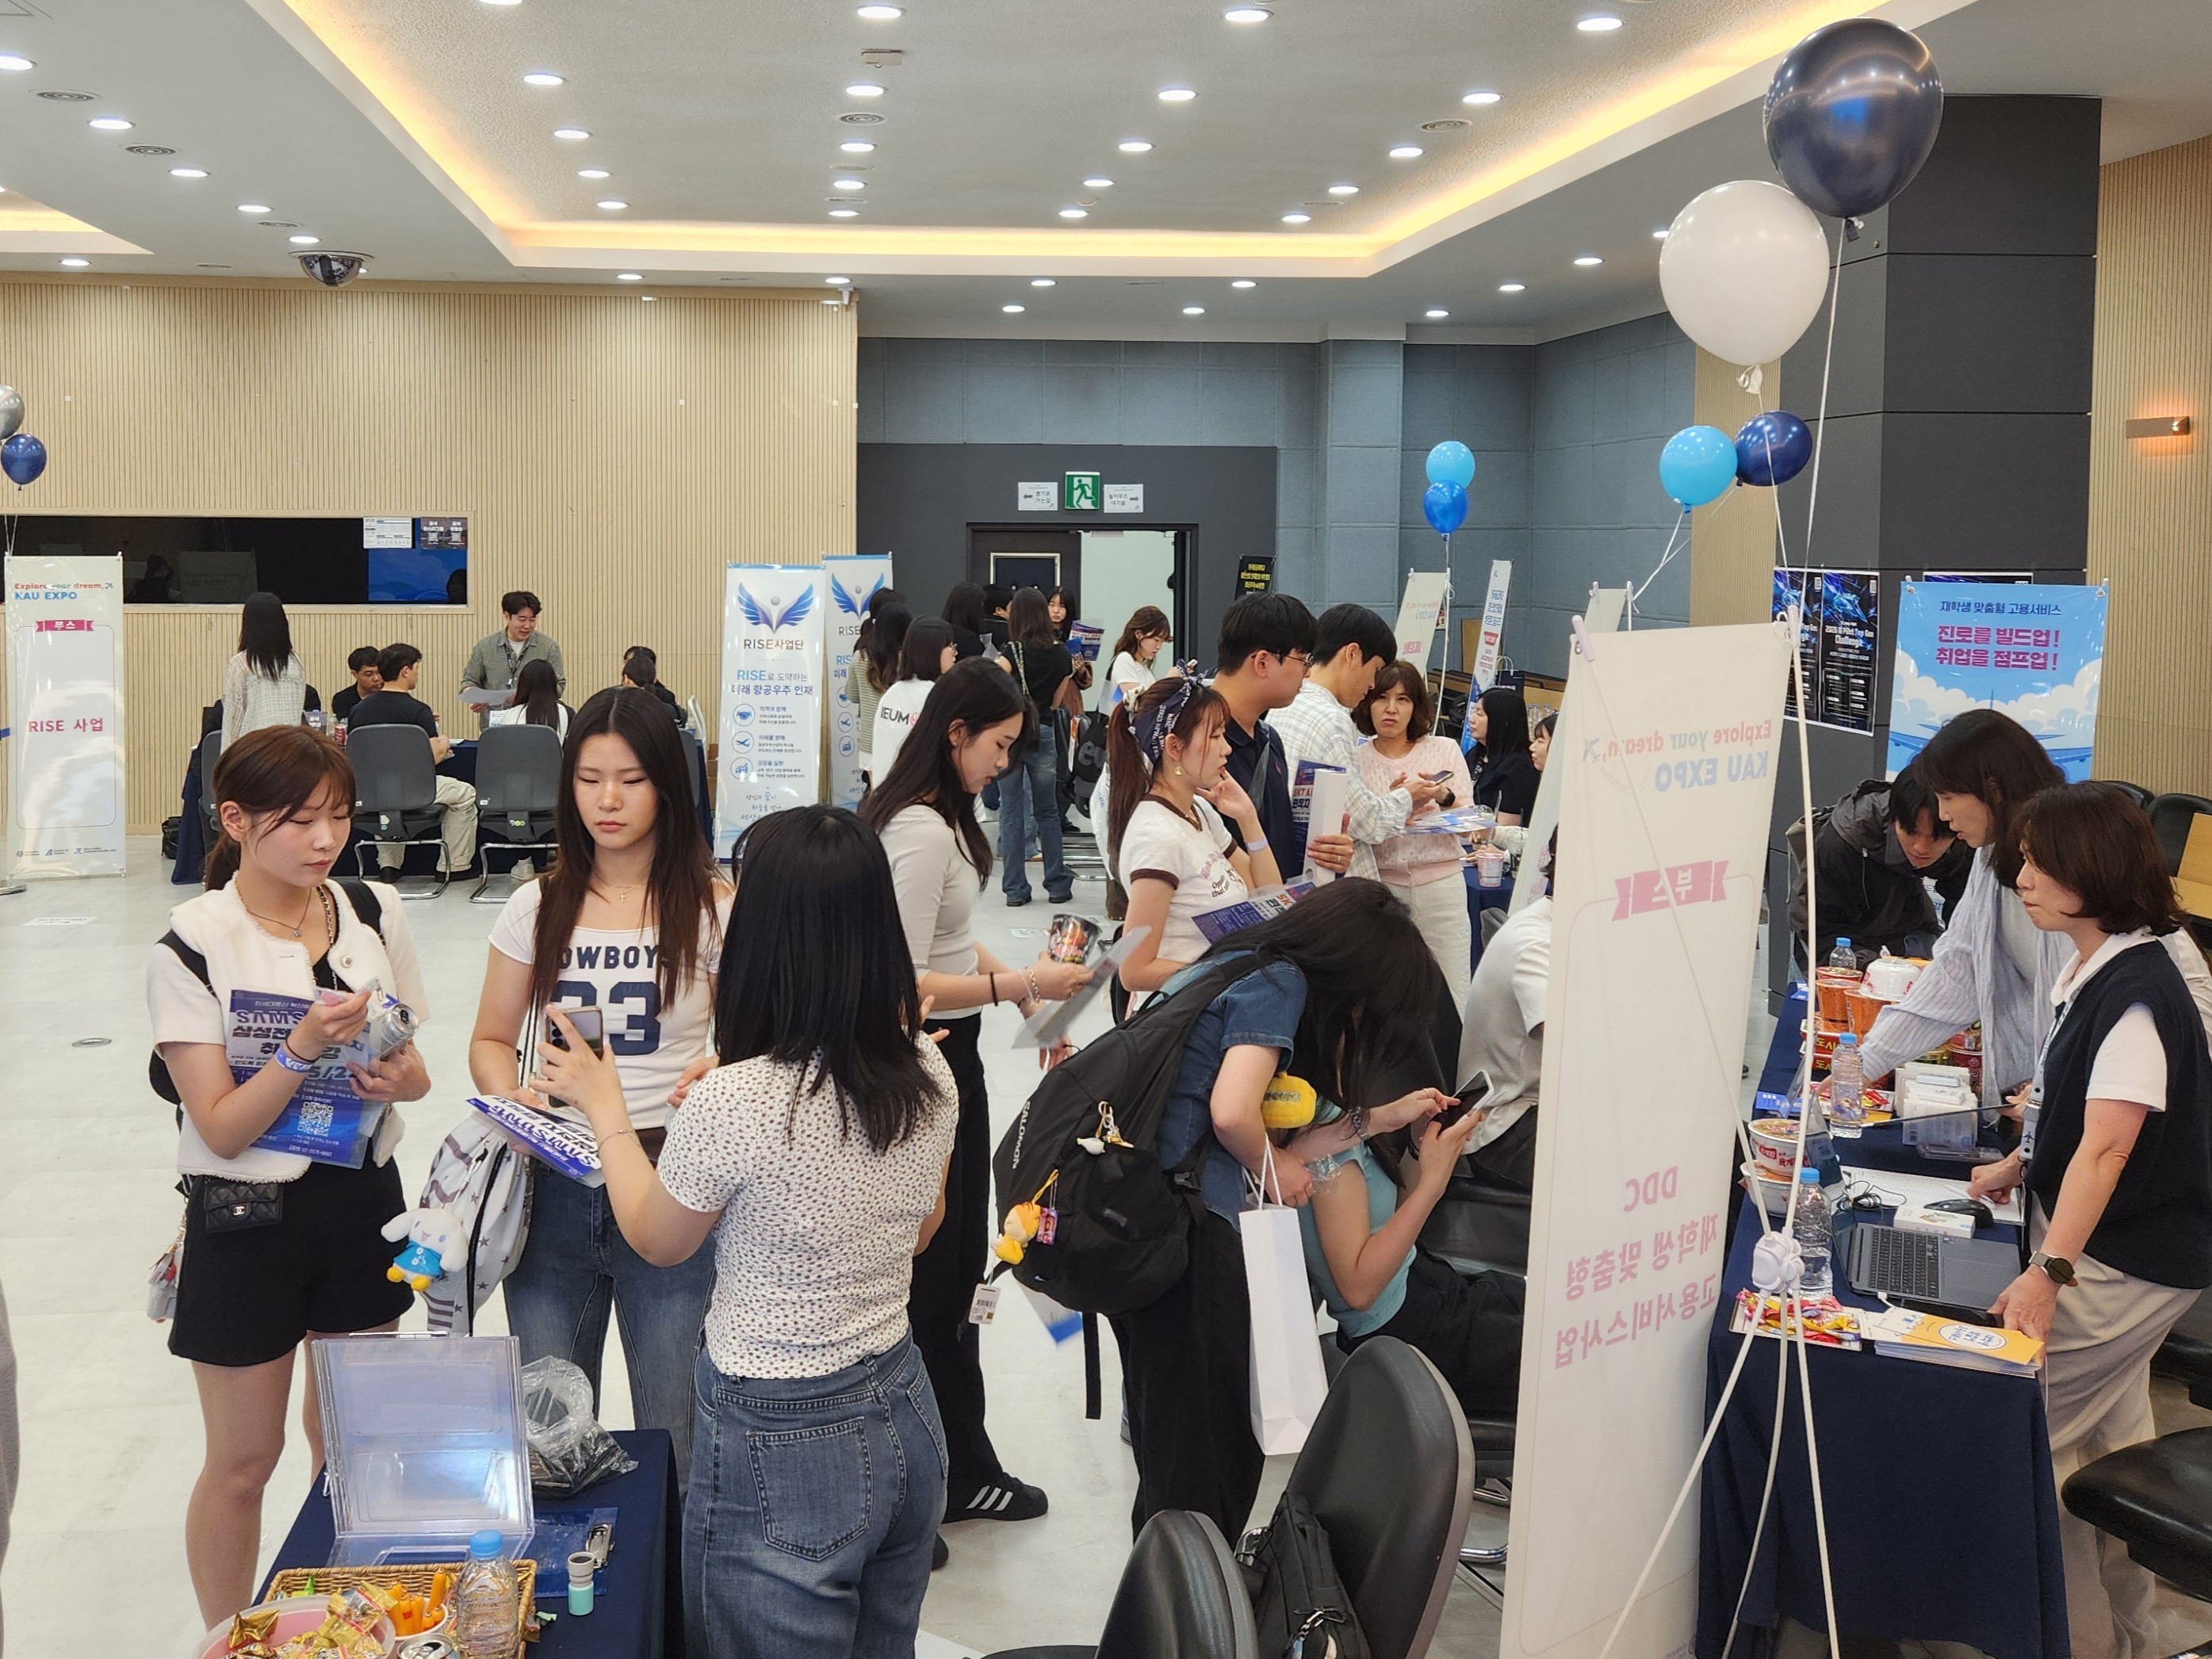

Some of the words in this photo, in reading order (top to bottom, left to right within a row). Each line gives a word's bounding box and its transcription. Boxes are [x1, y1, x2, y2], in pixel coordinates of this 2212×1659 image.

[1940, 601, 1972, 613] 재학생
[1973, 602, 2005, 614] 맞춤형
[2007, 603, 2062, 616] 고용서비스
[55, 621, 76, 630] 부스
[839, 626, 861, 636] RISE
[1938, 625, 1992, 645] 진로를
[744, 639, 805, 650] RISE사업단
[836, 655, 852, 665] RIS
[1936, 648, 1989, 667] 취업을
[737, 670, 775, 682] RISE로
[777, 673, 808, 682] 도약하는
[731, 684, 751, 695] 미래
[753, 685, 791, 696] 항공우주
[794, 685, 813, 696] 인재
[881, 706, 909, 725] IEUM
[29, 720, 65, 732] RISE
[73, 718, 104, 732] 사업
[557, 946, 660, 969] OWBOY
[235, 1009, 305, 1025] SAMS
[232, 1026, 293, 1040] 삼성전
[1816, 1037, 1837, 1051] 도시
[488, 1105, 593, 1168] SAMSUNG
[1012, 1100, 1031, 1169] SALOMON
